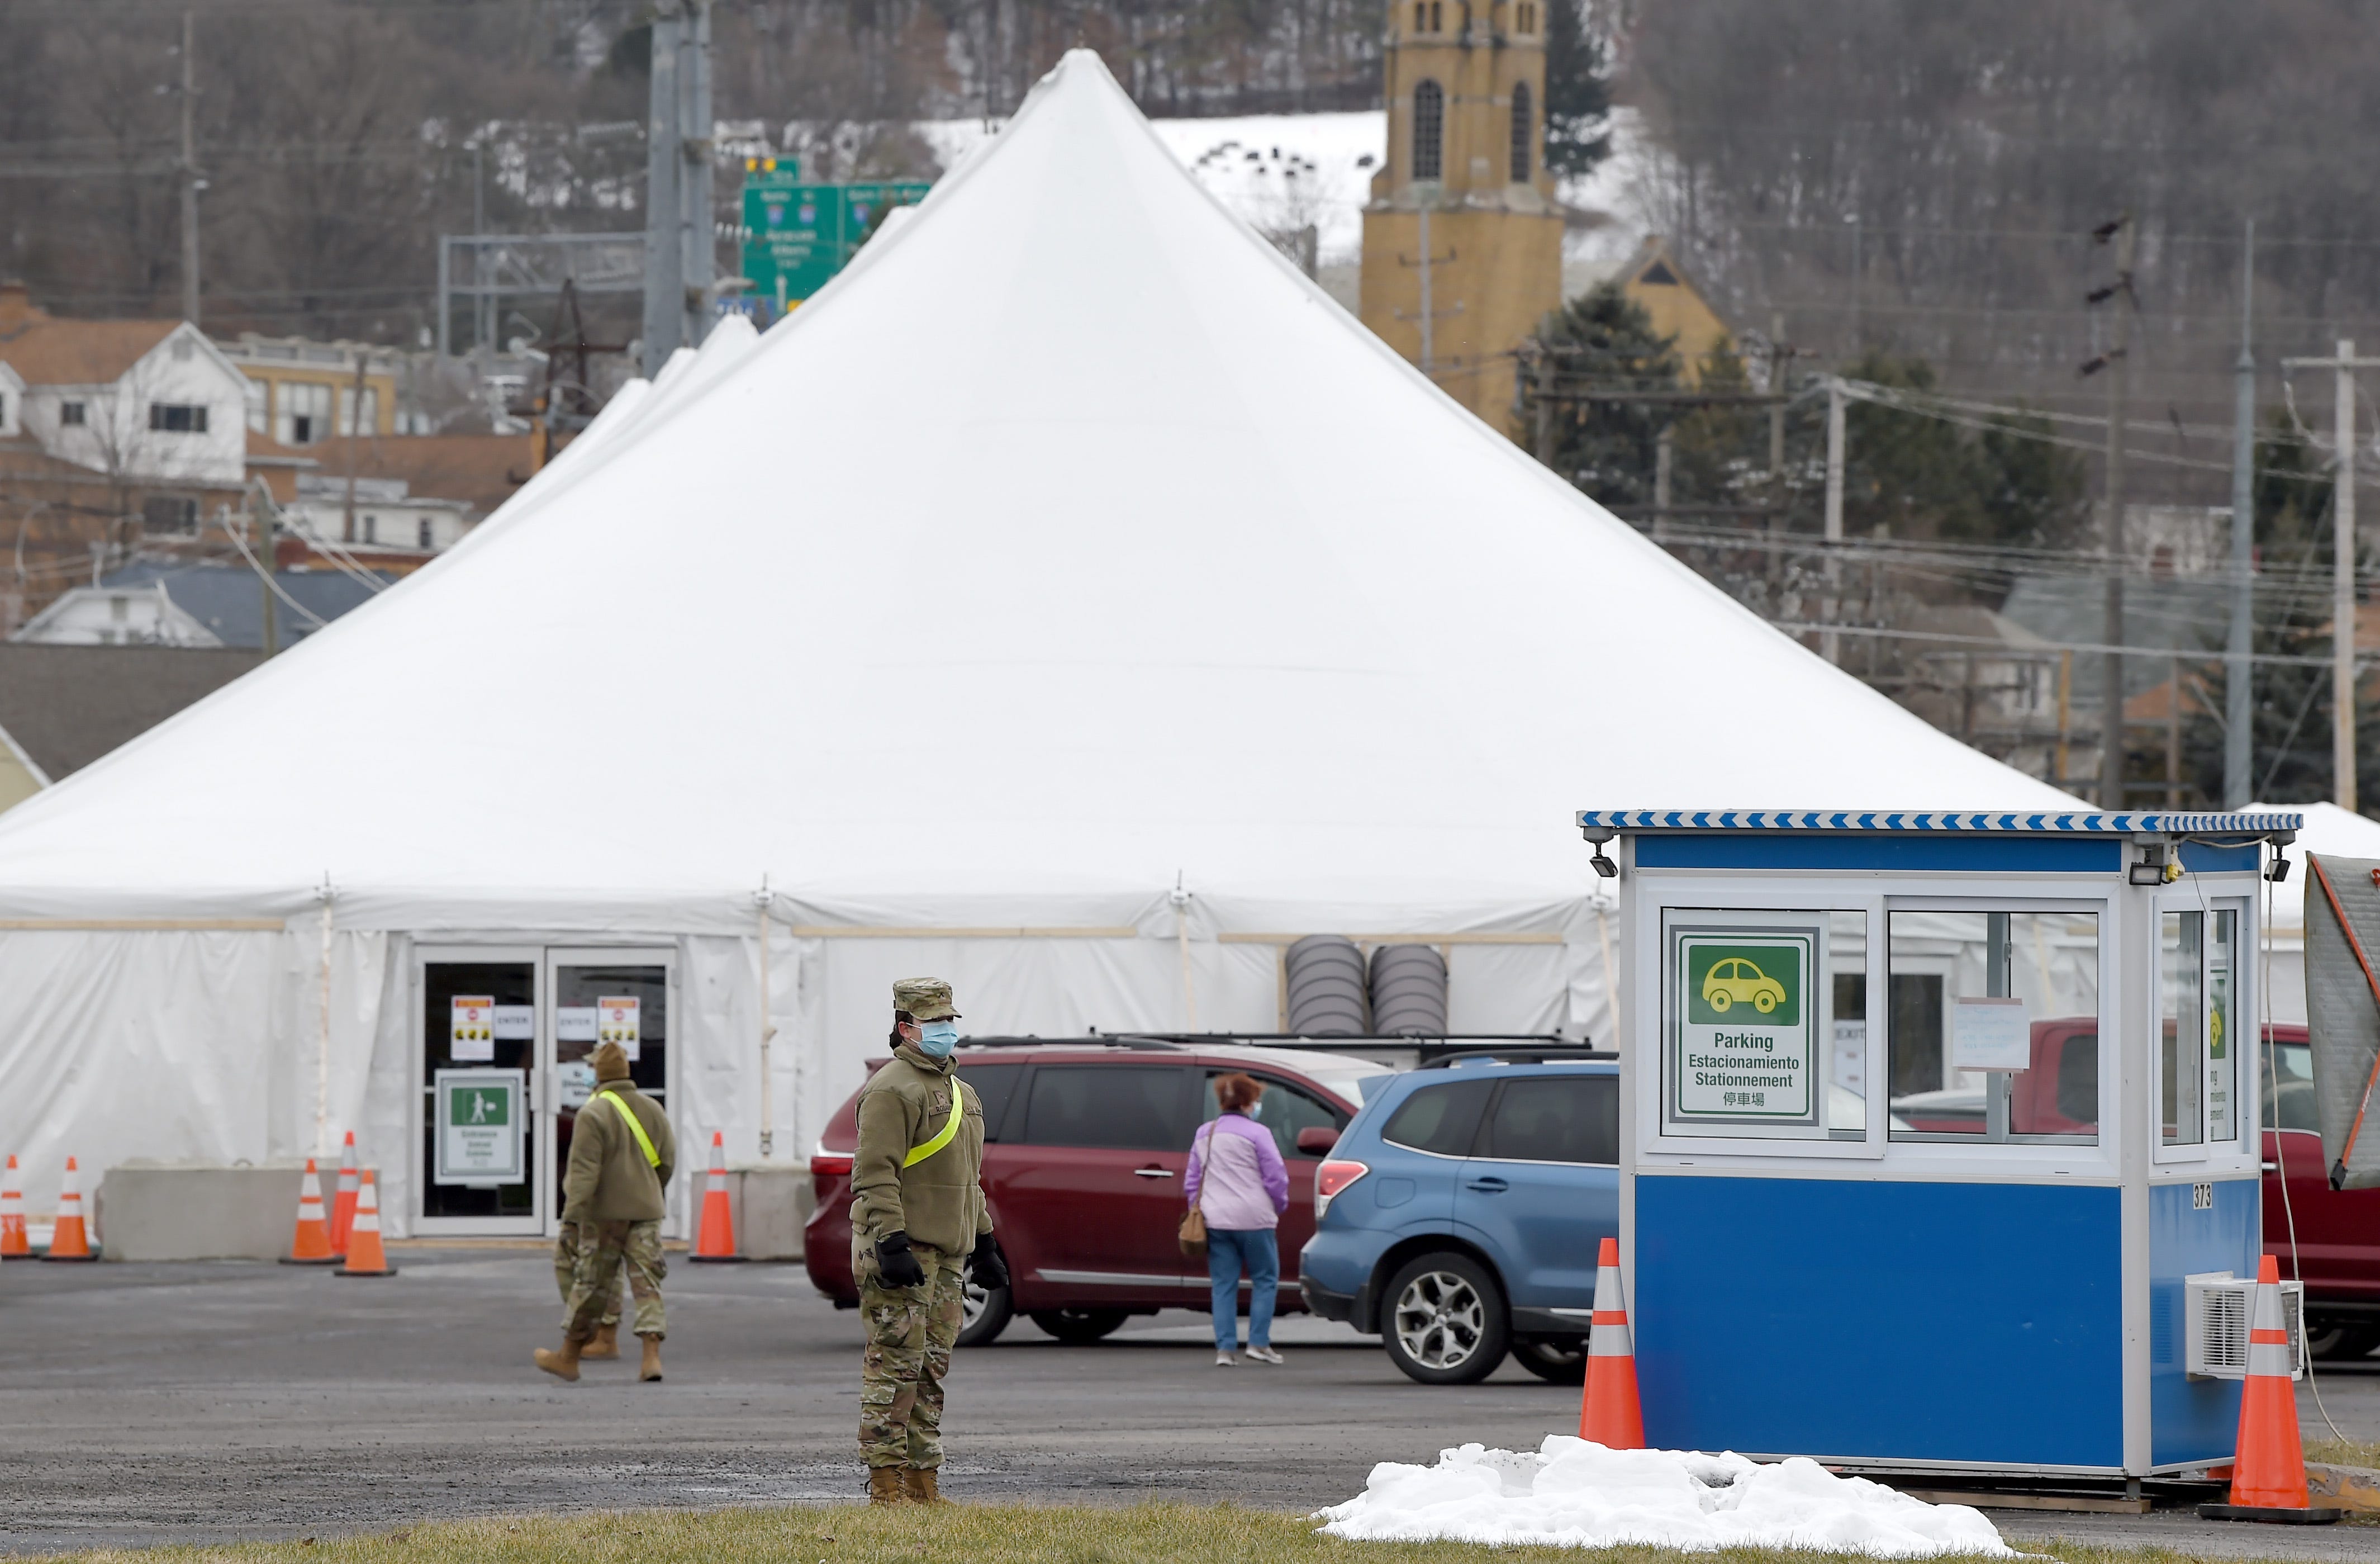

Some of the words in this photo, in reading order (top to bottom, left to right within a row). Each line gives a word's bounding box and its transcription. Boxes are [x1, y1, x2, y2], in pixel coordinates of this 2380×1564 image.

[1714, 1032, 1774, 1052] Parking
[1689, 1054, 1799, 1069] Estacionamiento
[1695, 1072, 1793, 1087] Stationnement
[1723, 1092, 1765, 1106] 停車場
[2194, 1184, 2211, 1207] 373
